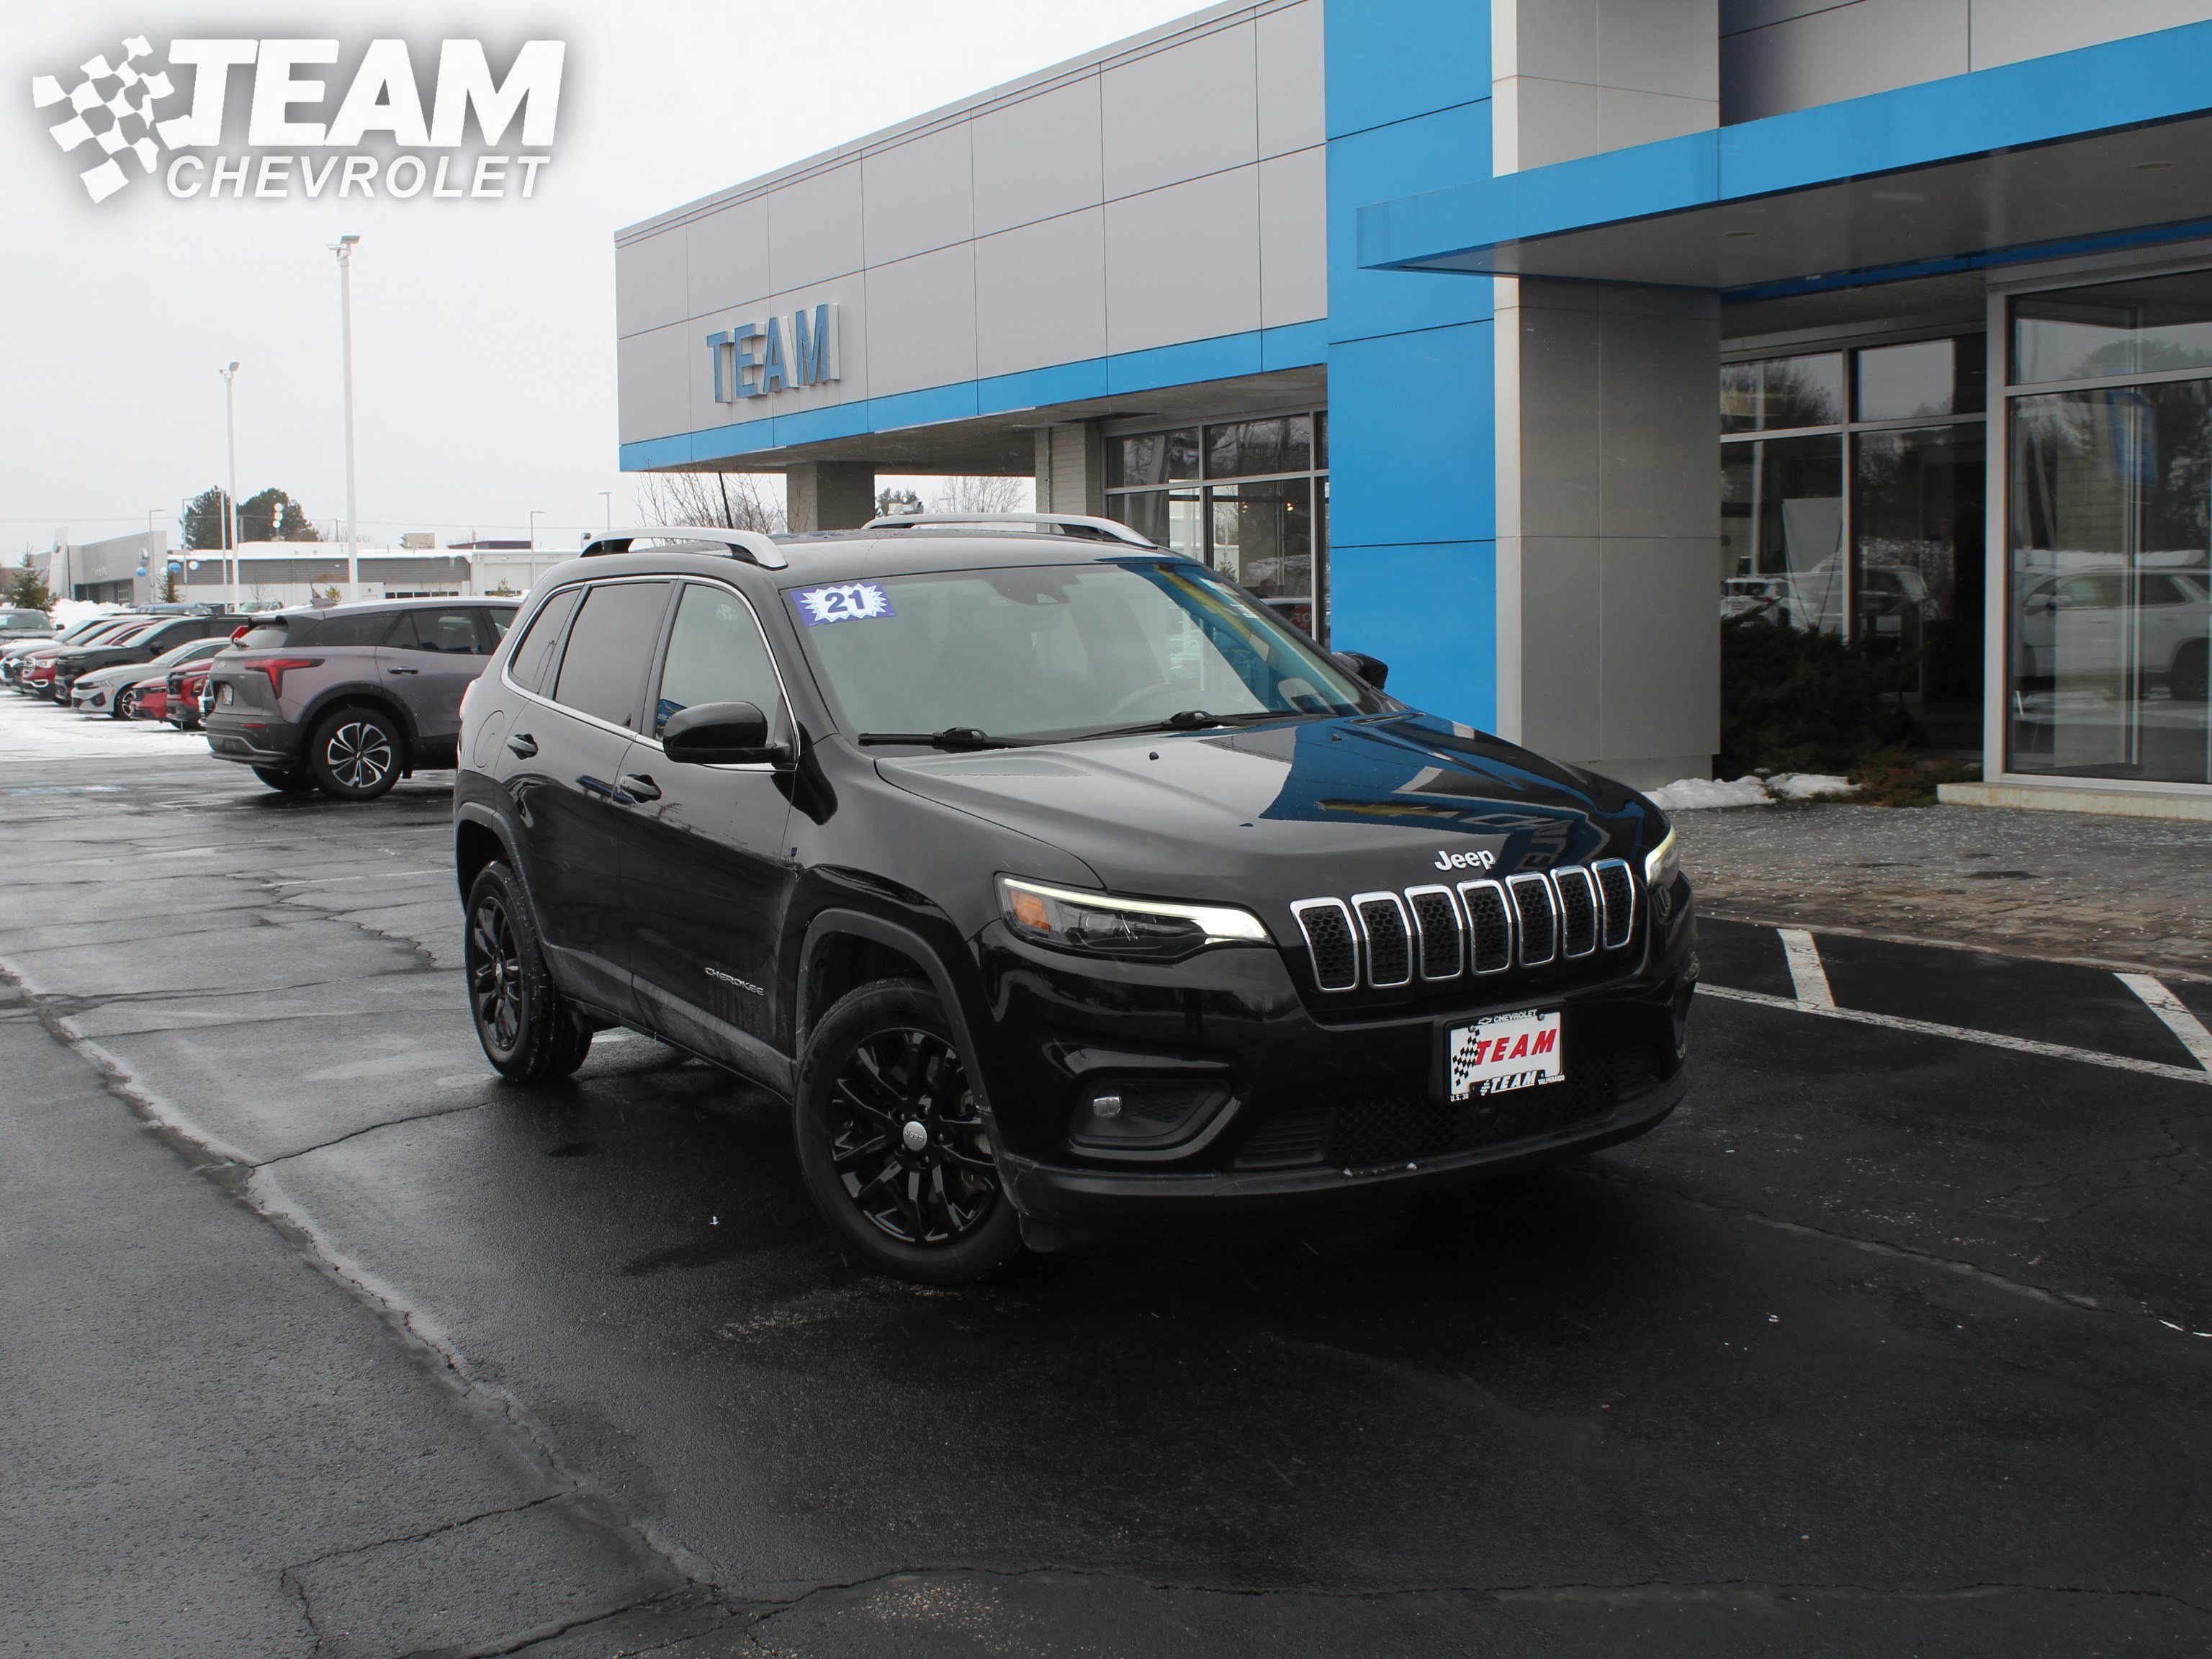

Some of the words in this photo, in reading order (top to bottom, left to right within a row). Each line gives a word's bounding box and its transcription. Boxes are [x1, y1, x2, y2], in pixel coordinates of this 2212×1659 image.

[706, 303, 840, 403] TEAM
[824, 590, 865, 613] 21
[1434, 850, 1496, 871] Jeep
[705, 967, 764, 996] CHEROKEE
[1493, 1010, 1537, 1022] CHEVROLET
[1475, 1028, 1557, 1065] TEAM
[1491, 1070, 1537, 1092] TEAM
[904, 1129, 923, 1141] Jeep
